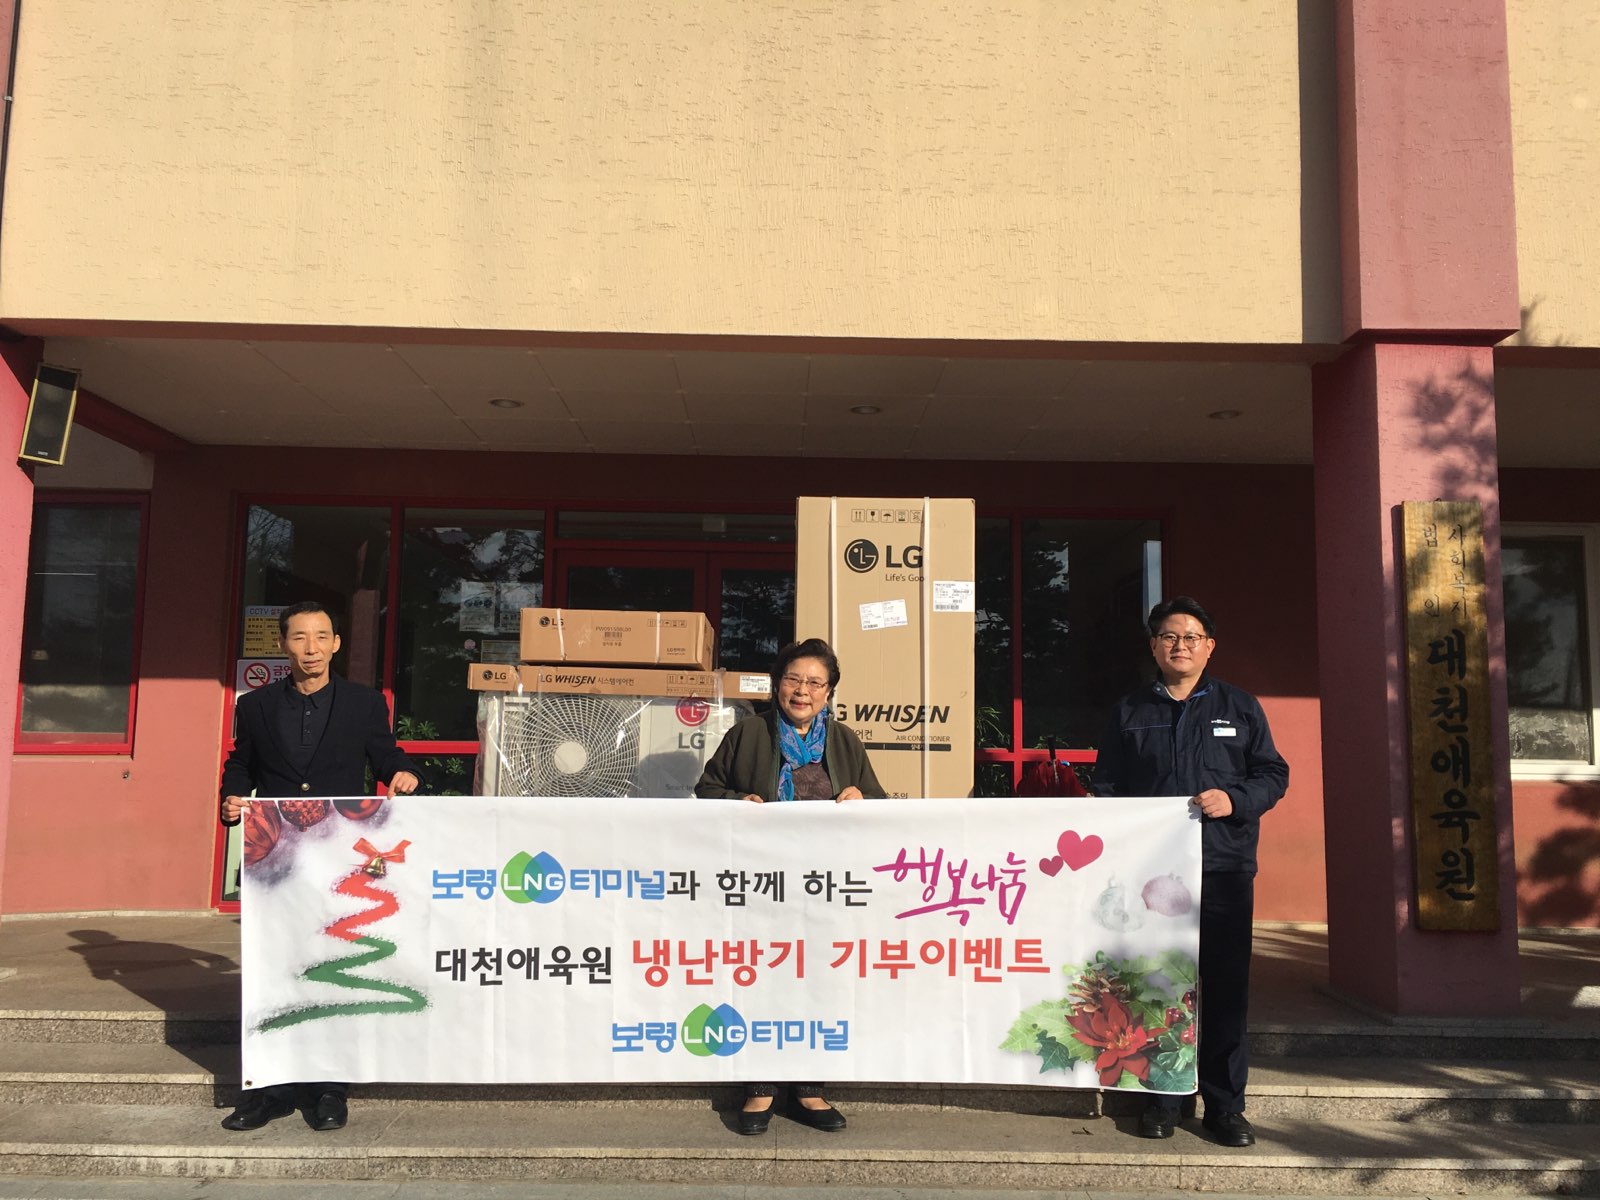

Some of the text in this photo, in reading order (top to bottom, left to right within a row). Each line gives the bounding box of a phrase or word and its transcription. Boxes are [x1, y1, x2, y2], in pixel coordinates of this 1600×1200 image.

[886, 545, 923, 569] LG
[885, 574, 925, 582] Life's Goo
[494, 671, 507, 680] LG
[540, 674, 635, 687] LG WHISEN 시스템에어컨
[855, 704, 951, 732] WHISEN
[678, 732, 705, 750] LG
[853, 729, 873, 740] 어컨
[1428, 628, 1480, 900] 대천애육원
[716, 869, 785, 906] 함께
[803, 870, 873, 907] 하는
[872, 846, 1027, 927] 행복나눔
[435, 937, 1051, 988] 대천애육원 냉난방기 기부이벤트
[612, 1020, 849, 1053] 보령LNG터미널
